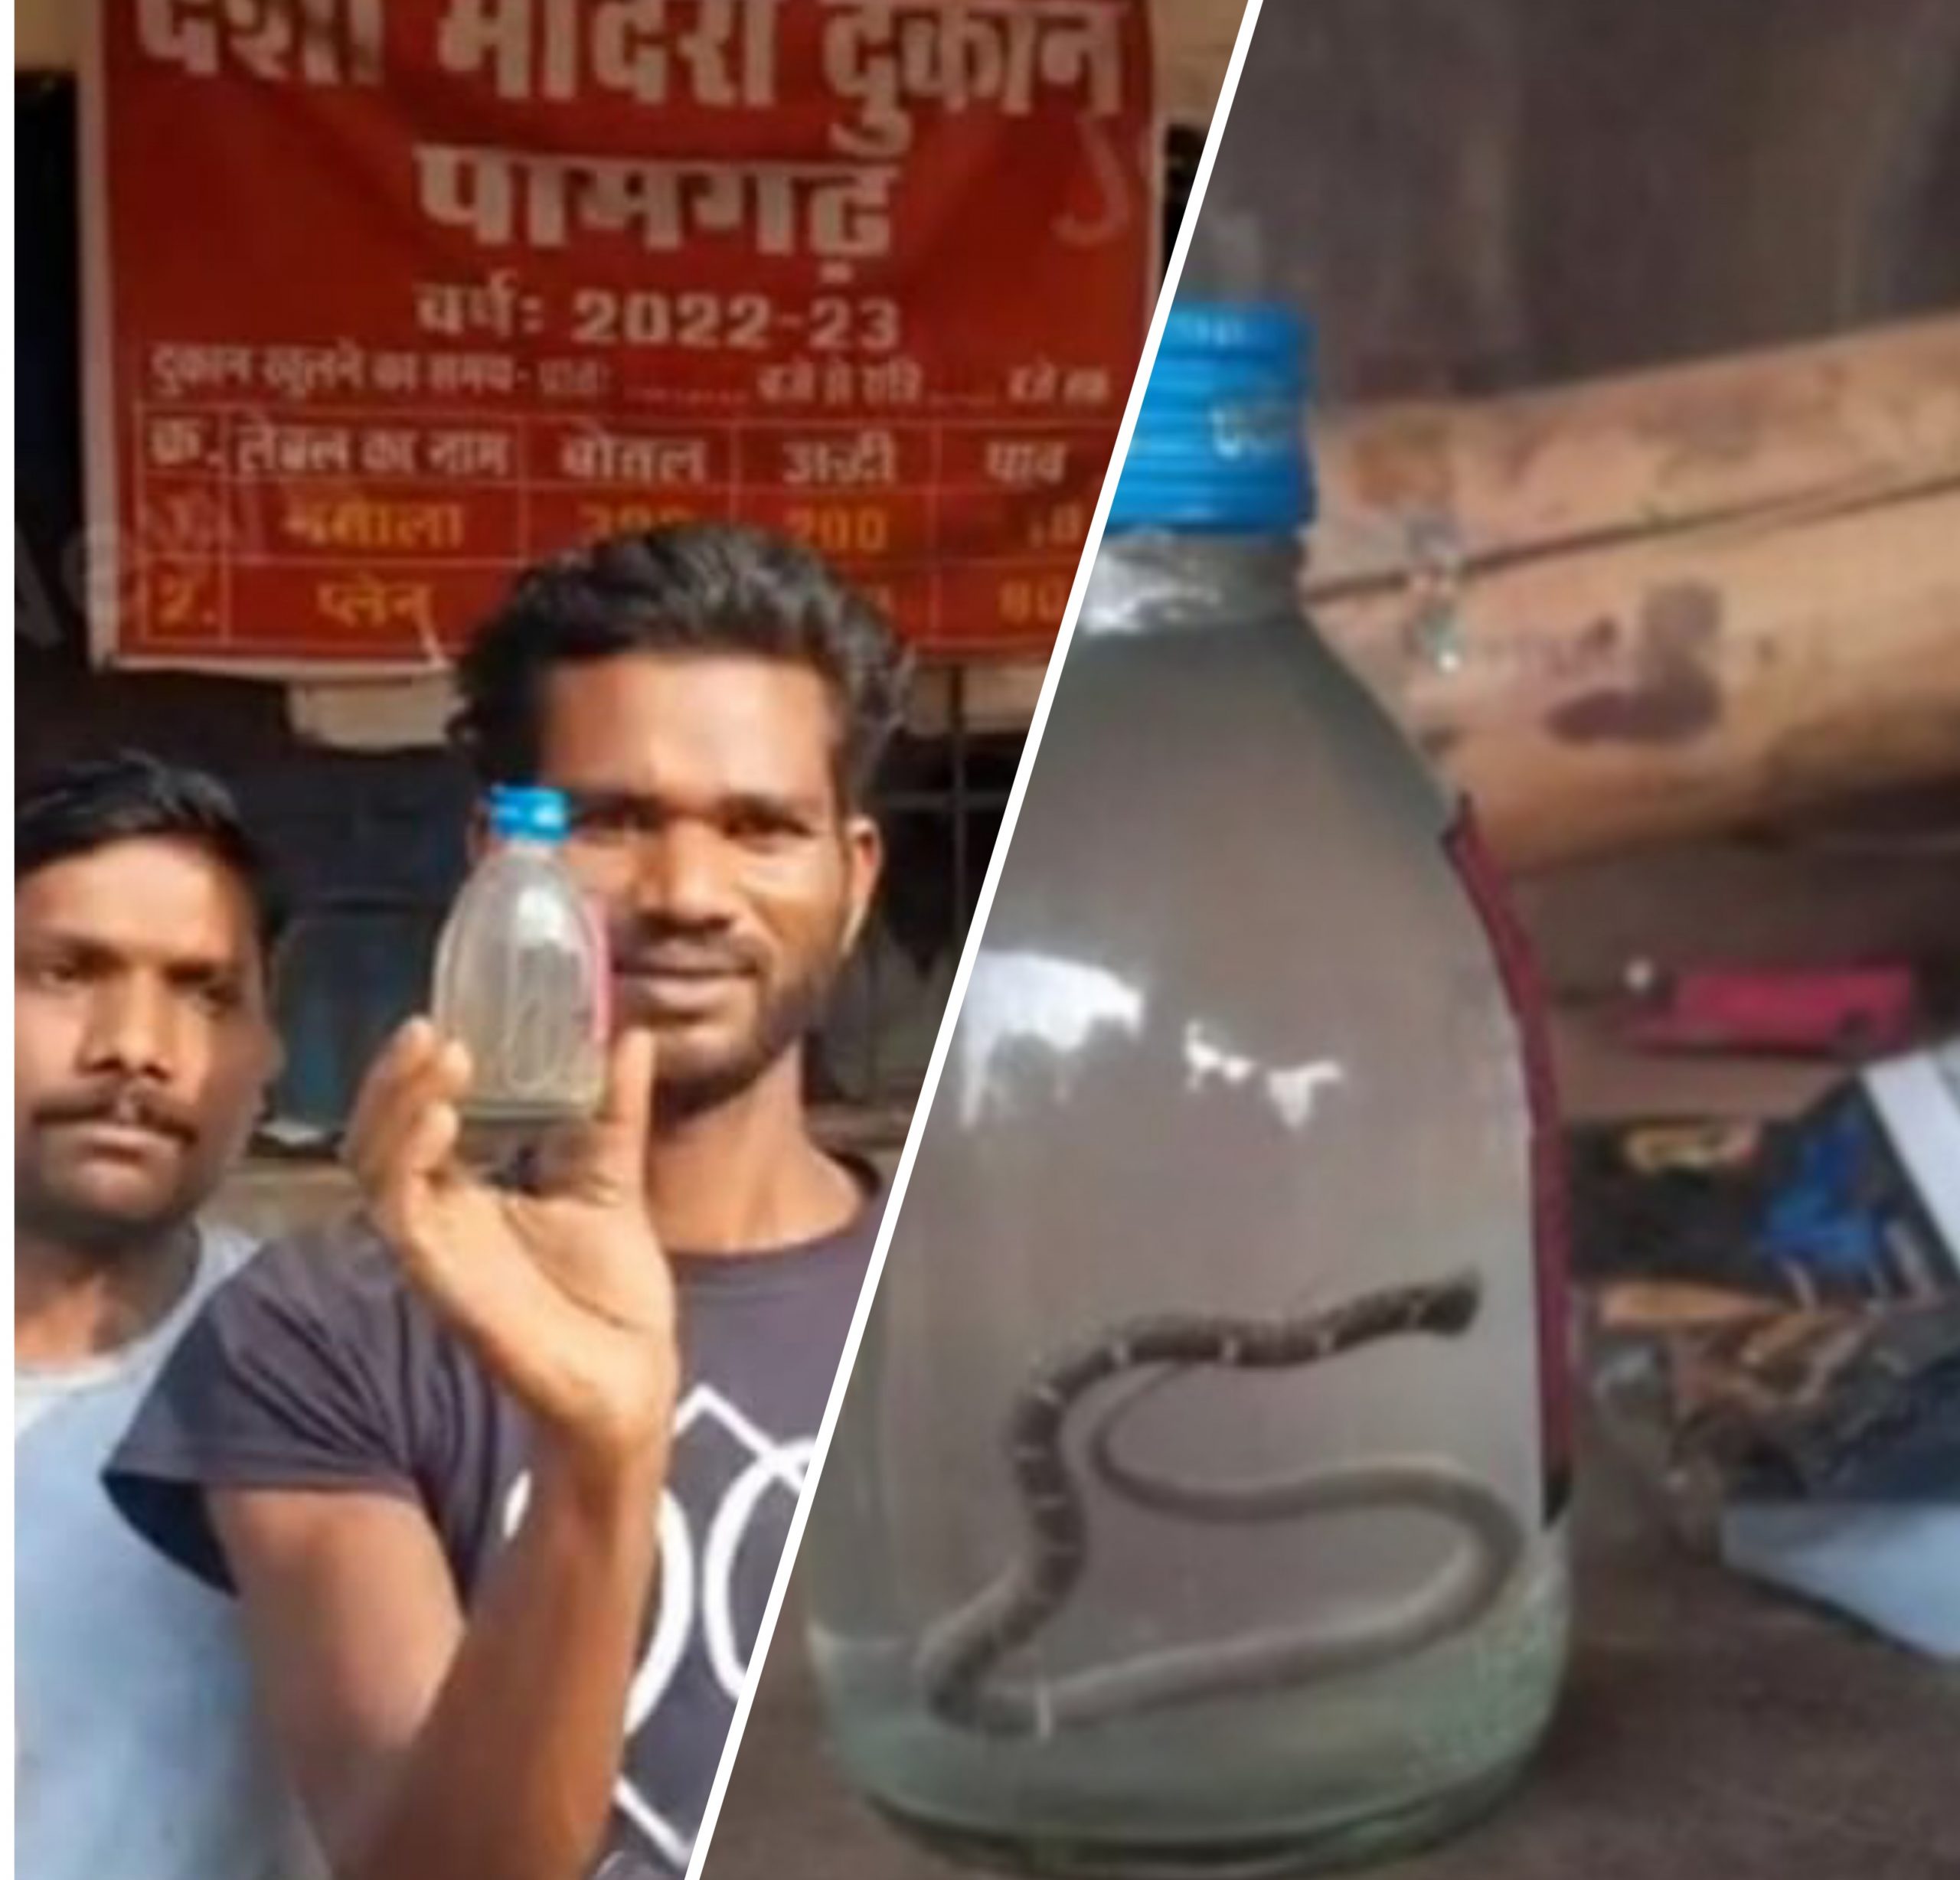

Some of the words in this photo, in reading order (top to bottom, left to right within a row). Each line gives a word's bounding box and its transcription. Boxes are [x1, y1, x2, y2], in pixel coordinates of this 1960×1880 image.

[822, 0, 1122, 156] दुकान
[413, 143, 901, 283] पामगढ़
[570, 289, 900, 351] 2022-23
[561, 419, 708, 486] बोतल
